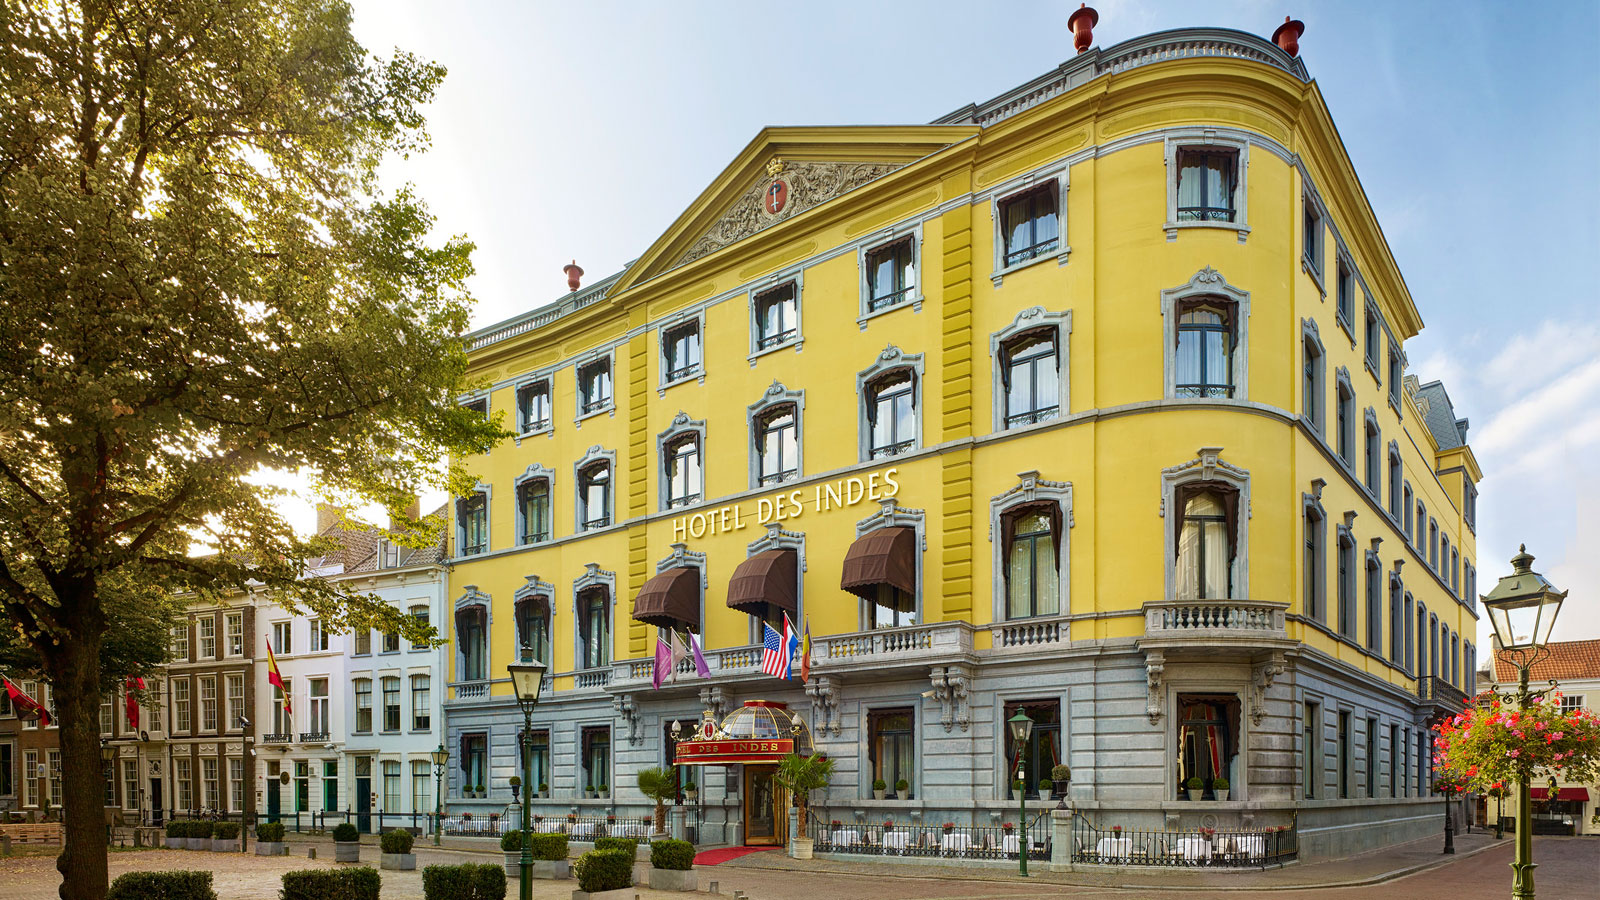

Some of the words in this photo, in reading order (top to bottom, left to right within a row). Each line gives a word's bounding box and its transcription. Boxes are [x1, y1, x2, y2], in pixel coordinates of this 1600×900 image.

[672, 505, 746, 542] HOTEL
[757, 490, 803, 524] DES
[815, 468, 899, 512] INDES
[699, 745, 719, 753] DES
[733, 743, 779, 752] INDES
